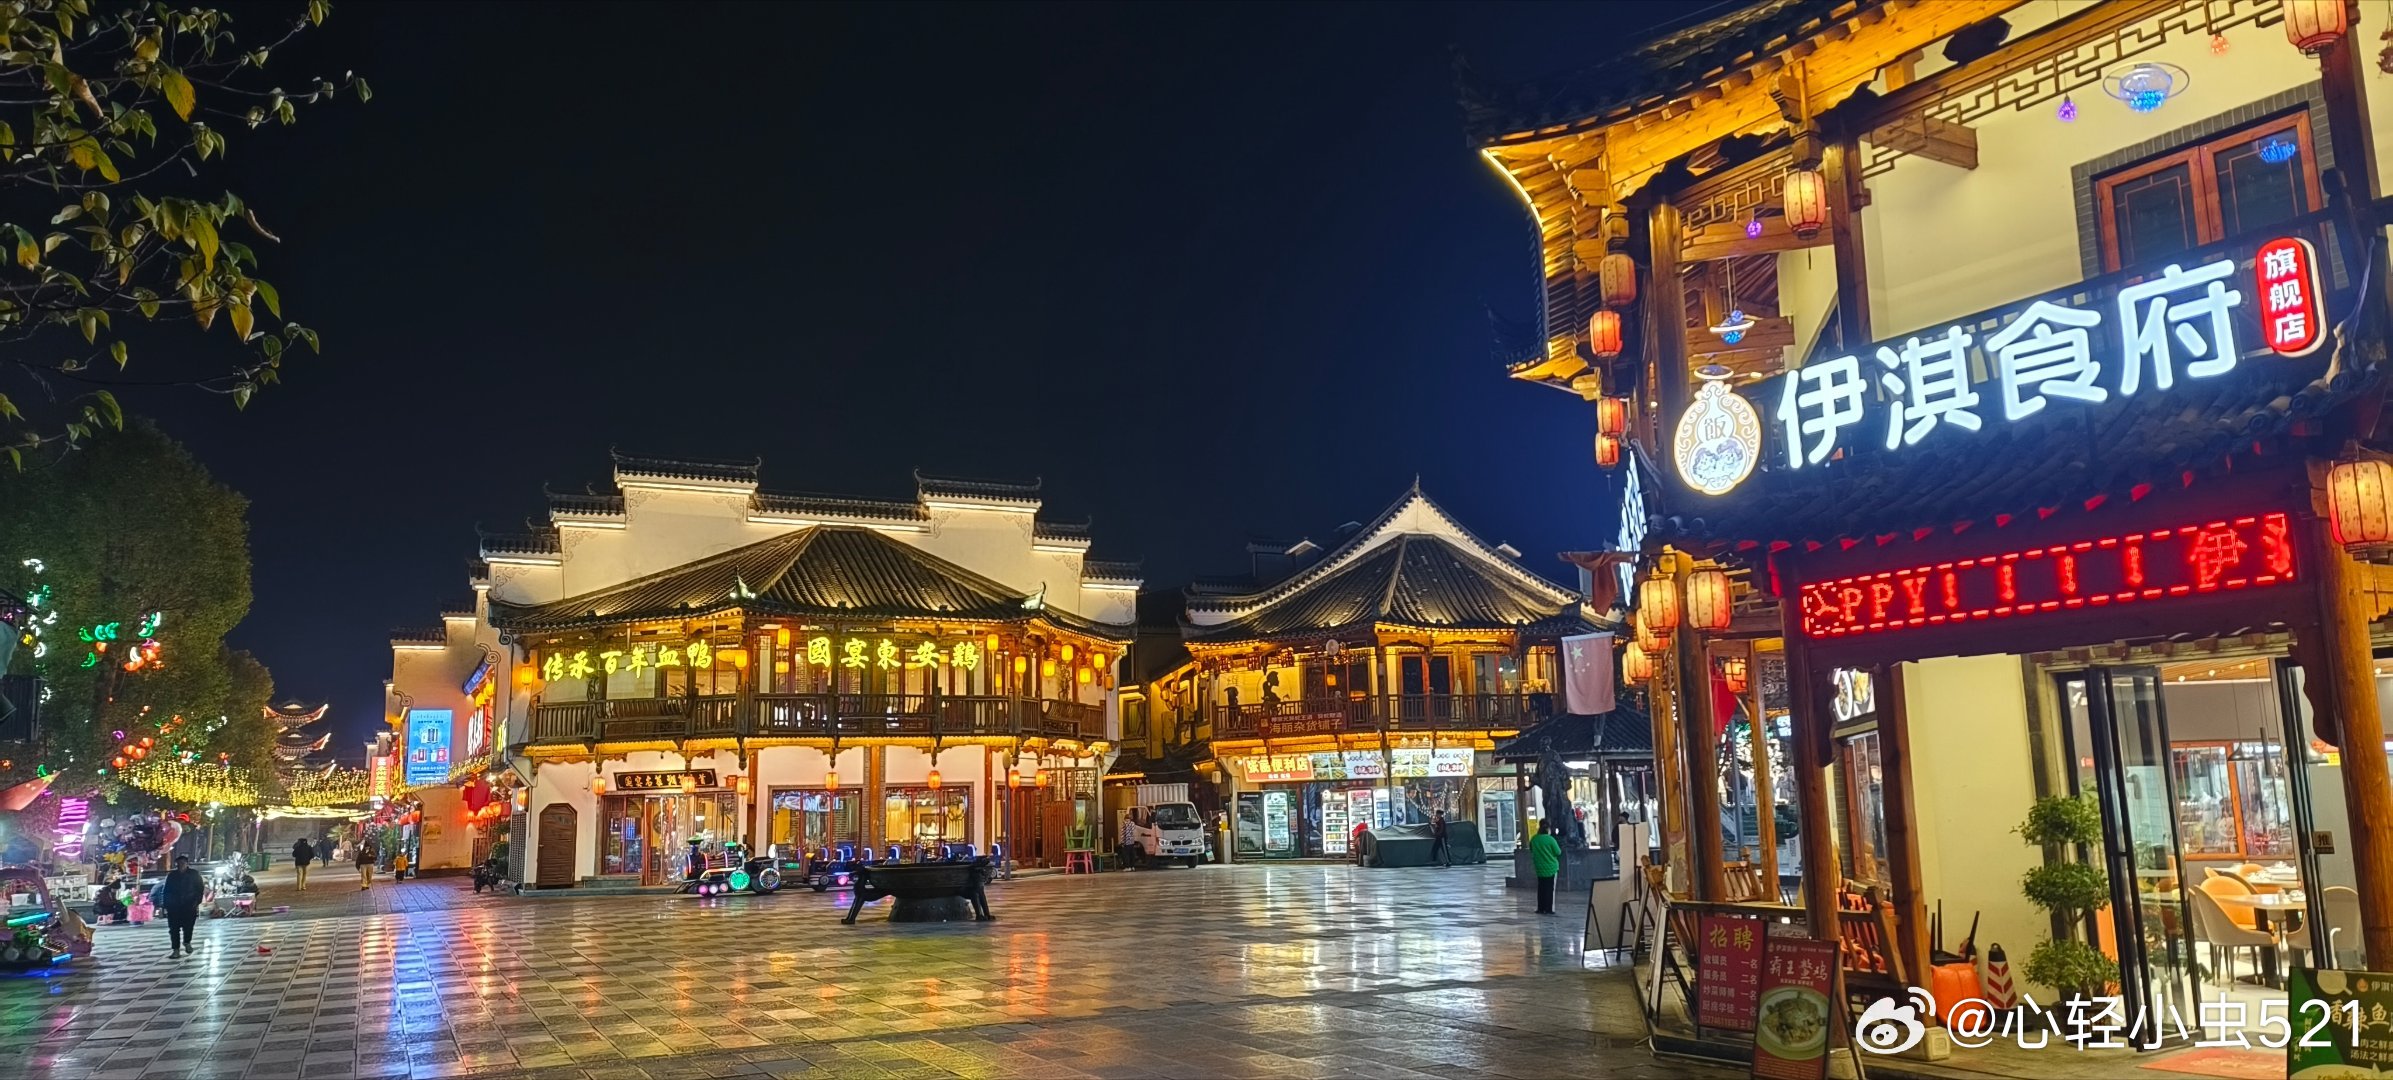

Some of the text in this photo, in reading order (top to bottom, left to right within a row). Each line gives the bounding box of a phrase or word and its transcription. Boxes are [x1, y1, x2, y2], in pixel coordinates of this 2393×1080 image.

[2264, 247, 2304, 344] 旗舰店
[1775, 257, 2243, 470] 伊淇食府
[543, 639, 713, 682] 传承百年血鸭
[1269, 717, 1343, 734] 海丽杂货铺子
[1709, 924, 1755, 952] 招聘
[1741, 958, 1759, 969] 一名
[1703, 969, 1758, 985] 服务员 二名
[2371, 980, 2393, 992] 伊淇
[1740, 989, 1757, 1001] 一名
[1740, 1005, 1757, 1018] 一名
